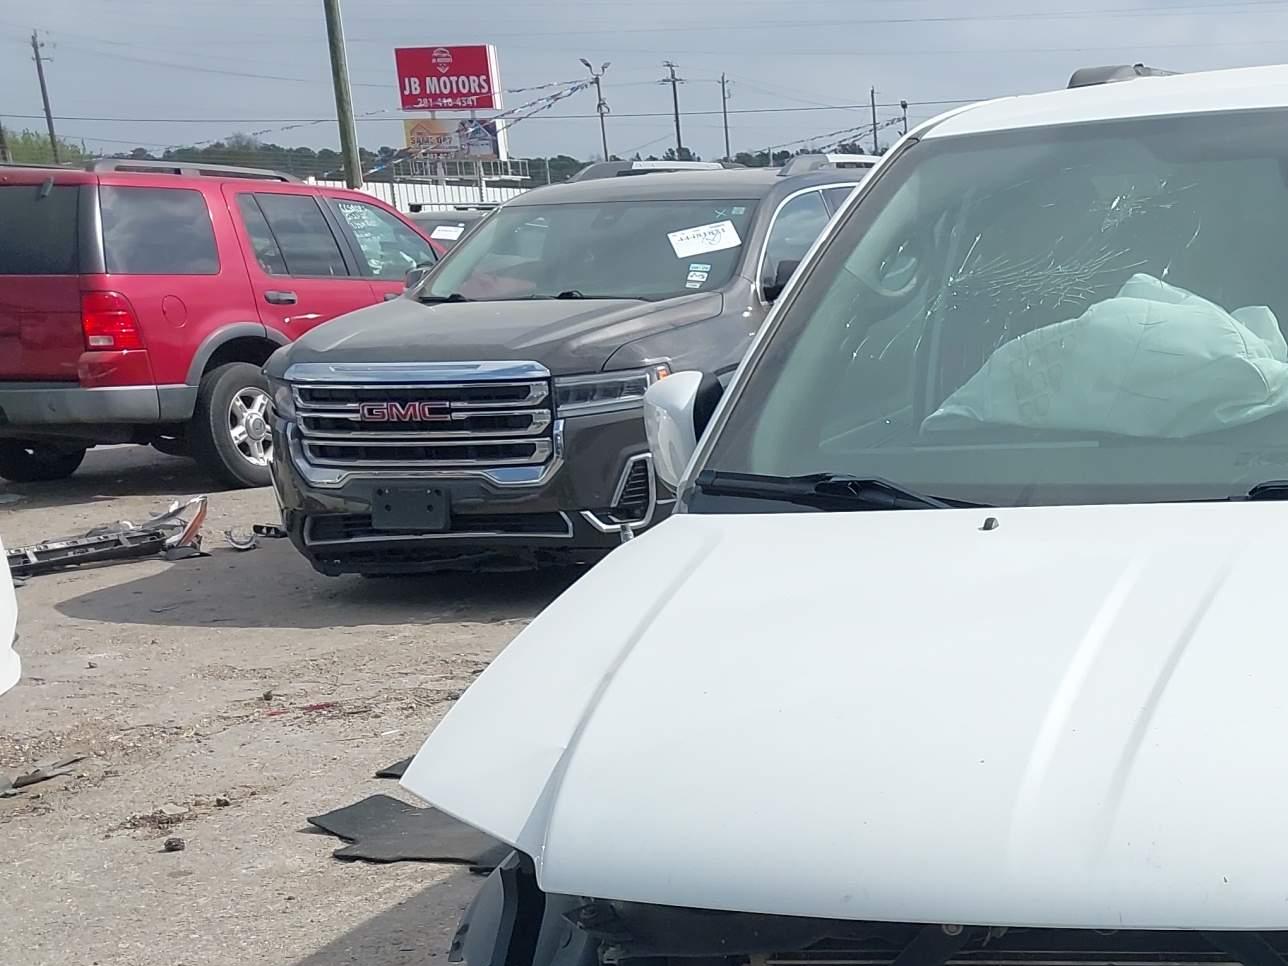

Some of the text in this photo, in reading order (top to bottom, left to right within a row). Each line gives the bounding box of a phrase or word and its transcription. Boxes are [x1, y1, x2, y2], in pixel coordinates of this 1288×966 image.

[404, 75, 489, 95] JB MOTORS
[360, 401, 451, 421] GMC
